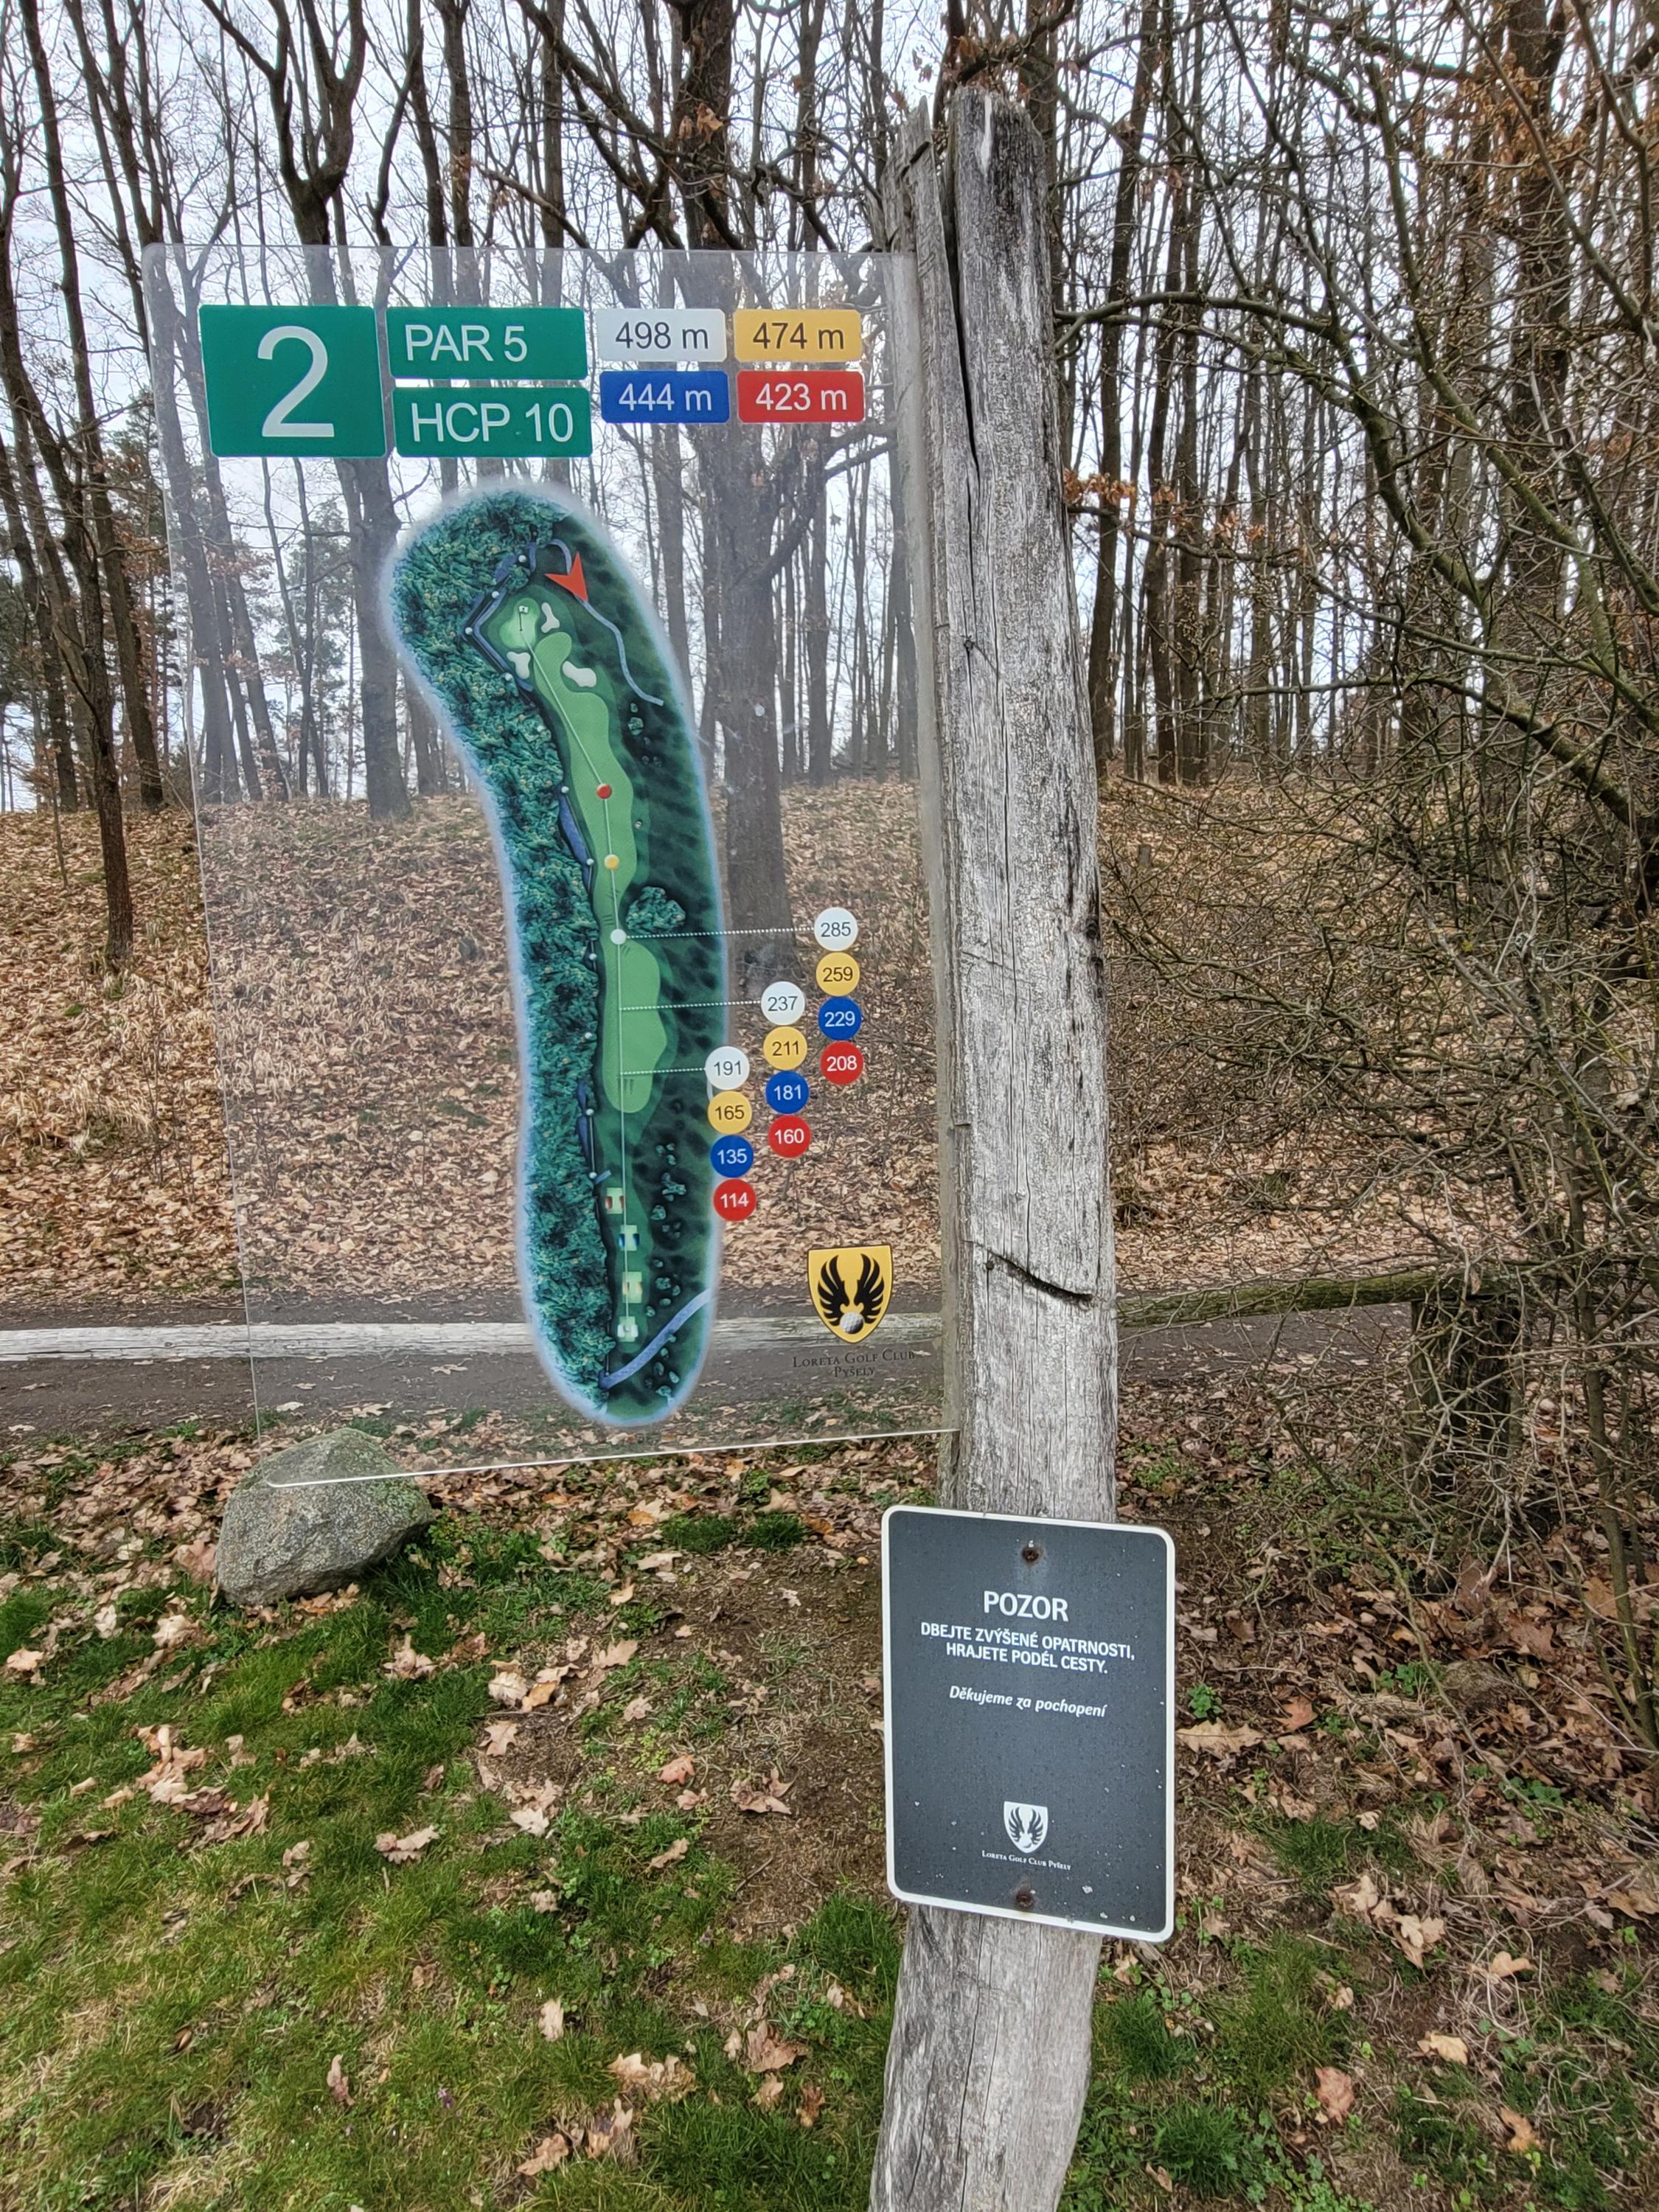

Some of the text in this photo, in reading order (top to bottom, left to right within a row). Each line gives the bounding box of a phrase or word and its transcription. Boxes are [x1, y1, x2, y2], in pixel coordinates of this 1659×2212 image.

[404, 324, 528, 362] PAR 5
[615, 321, 709, 349] 498 m
[753, 322, 844, 349] 474 m
[257, 325, 335, 437] 2
[618, 383, 712, 411] 444 m
[756, 383, 847, 411] 423 m
[411, 403, 574, 442] HCP 10
[820, 922, 851, 938] 285
[822, 966, 853, 982] 259
[768, 996, 798, 1012] 237
[824, 1010, 855, 1027] 229
[772, 1040, 799, 1057] 211
[714, 1060, 742, 1077] 191
[826, 1055, 858, 1072] 208
[773, 1085, 801, 1101] 181
[714, 1105, 745, 1120] 165
[774, 1128, 804, 1144] 160
[717, 1148, 748, 1164] 135
[720, 1192, 749, 1208] 114
[983, 1590, 1069, 1622] POZOR
[921, 1622, 1135, 1660] DBEJTE ZVÝŠENÉ OPATRNOSTI,
[946, 1642, 1109, 1674] HRAJETE PODÉL CESTY.
[949, 1685, 1108, 1718] Děkujeme za pochopení
